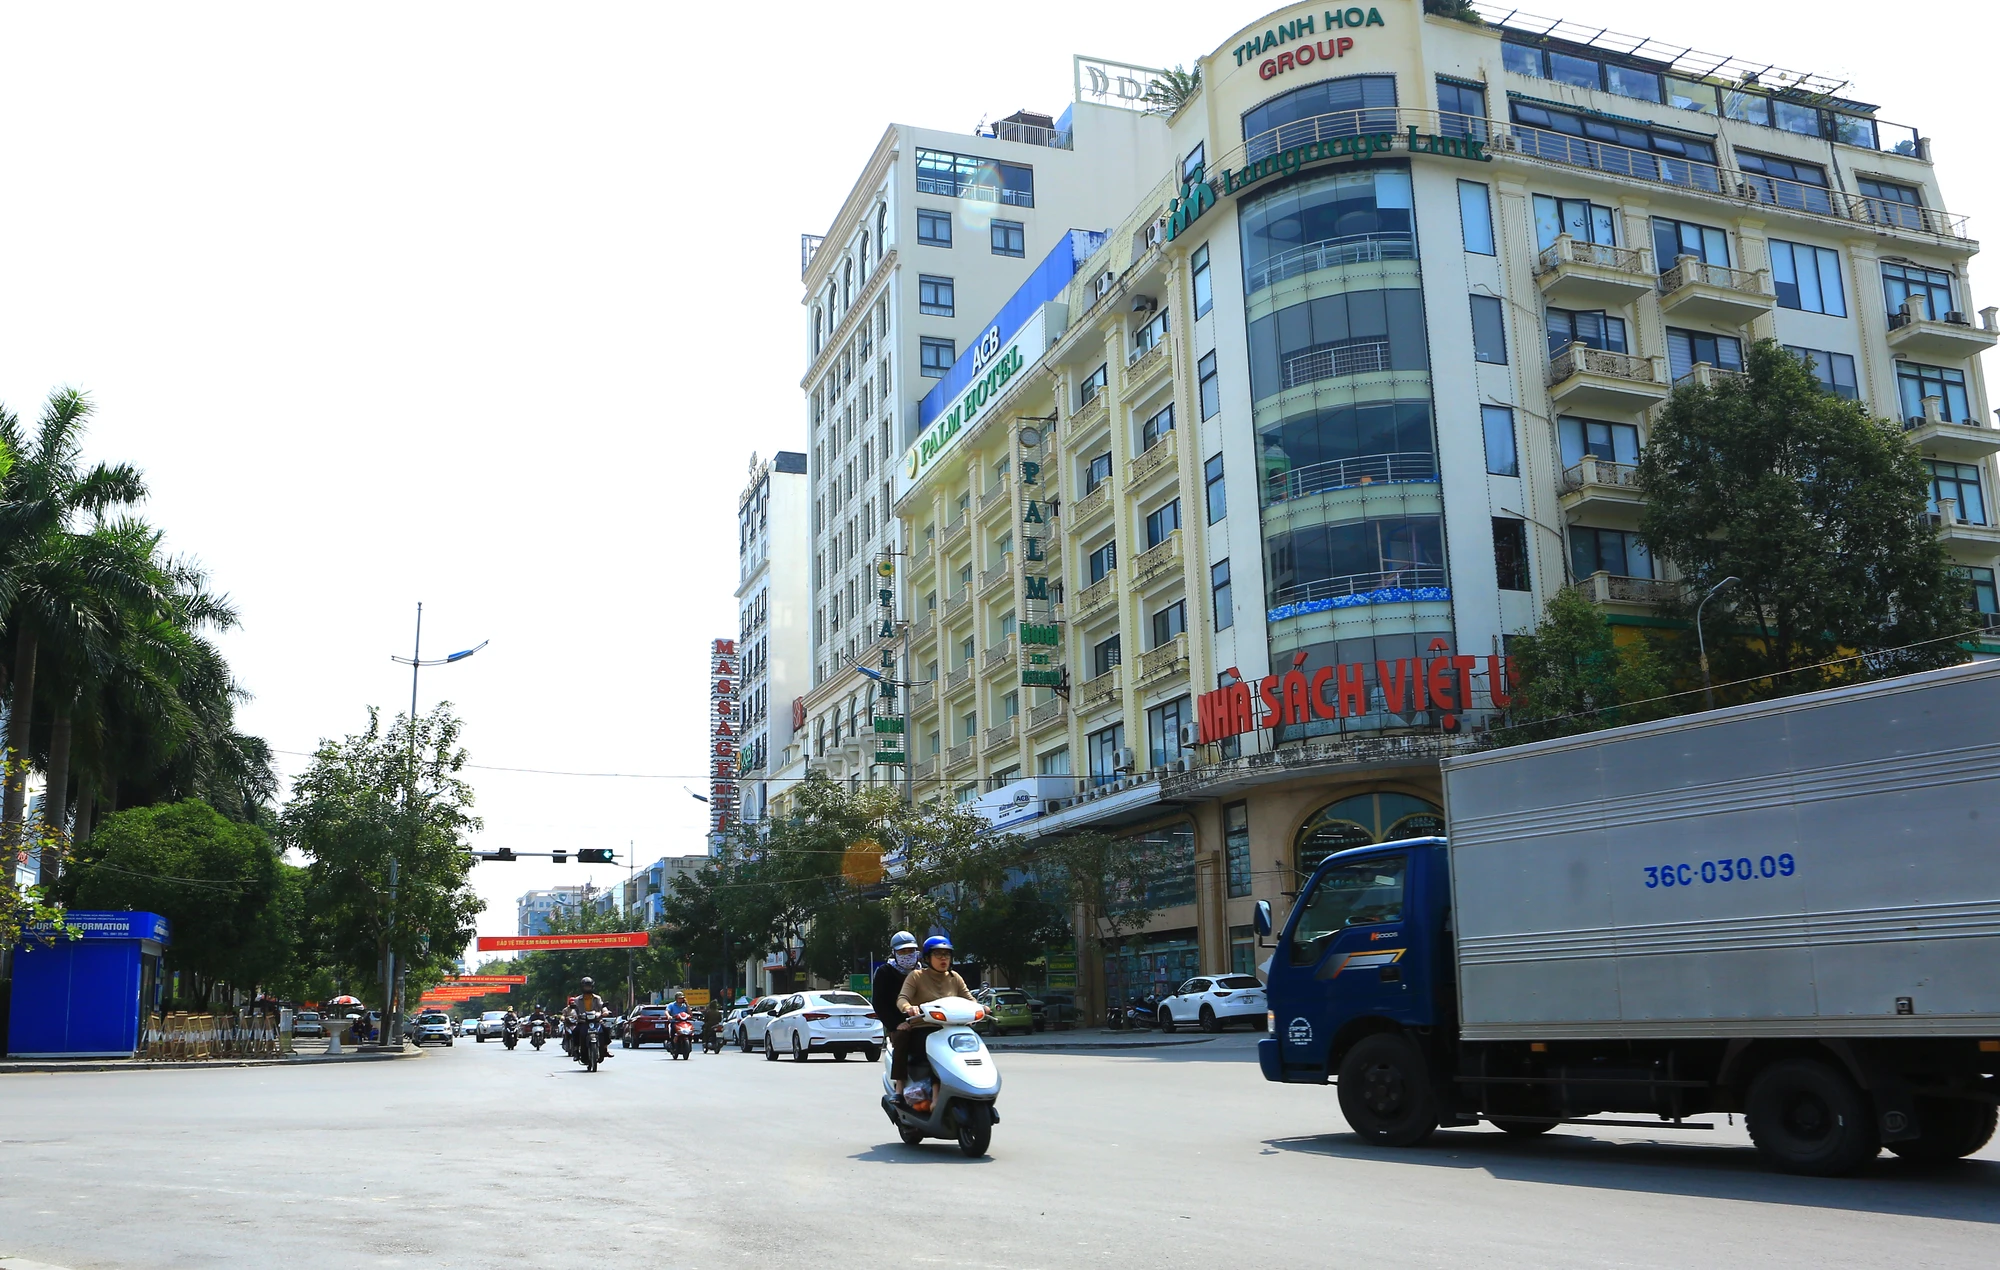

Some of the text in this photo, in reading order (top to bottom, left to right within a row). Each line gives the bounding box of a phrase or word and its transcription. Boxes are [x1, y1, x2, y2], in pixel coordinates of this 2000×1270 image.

[1233, 7, 1384, 66] THANH HOA
[1259, 37, 1354, 80] GROUP
[1222, 132, 1392, 196] Language
[972, 325, 999, 377] ACB
[920, 345, 1023, 467] PALM HOTEL
[1023, 461, 1048, 600] PALM
[879, 589, 898, 697] PALM
[1020, 623, 1058, 646] Hotel
[715, 639, 734, 778] MASSAGE
[1198, 666, 1252, 744] NHÀ
[1260, 652, 1366, 728] SÁCH
[1376, 638, 1475, 732] VIỆT
